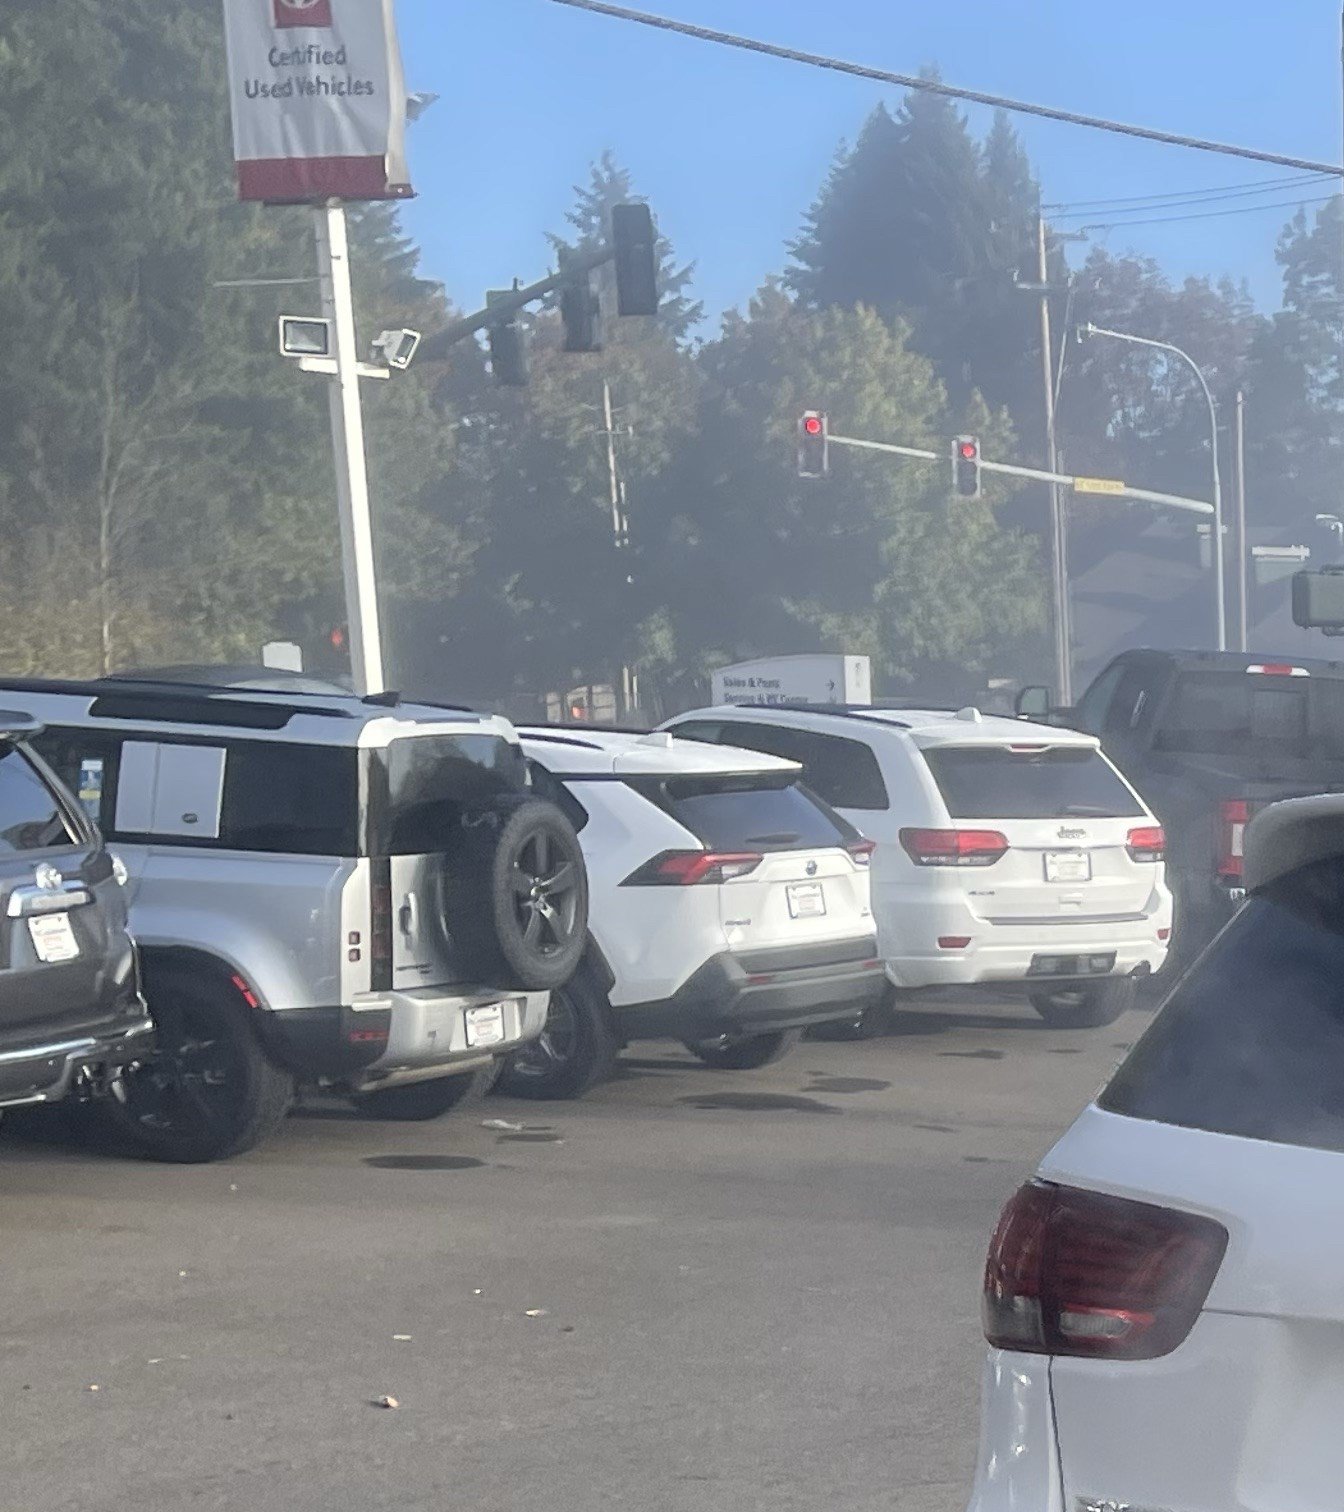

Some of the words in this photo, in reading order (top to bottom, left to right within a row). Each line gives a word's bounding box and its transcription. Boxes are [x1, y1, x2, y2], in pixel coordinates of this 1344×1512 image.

[268, 44, 347, 68] Certified
[244, 76, 292, 99] Used
[296, 74, 375, 97] Vehicles
